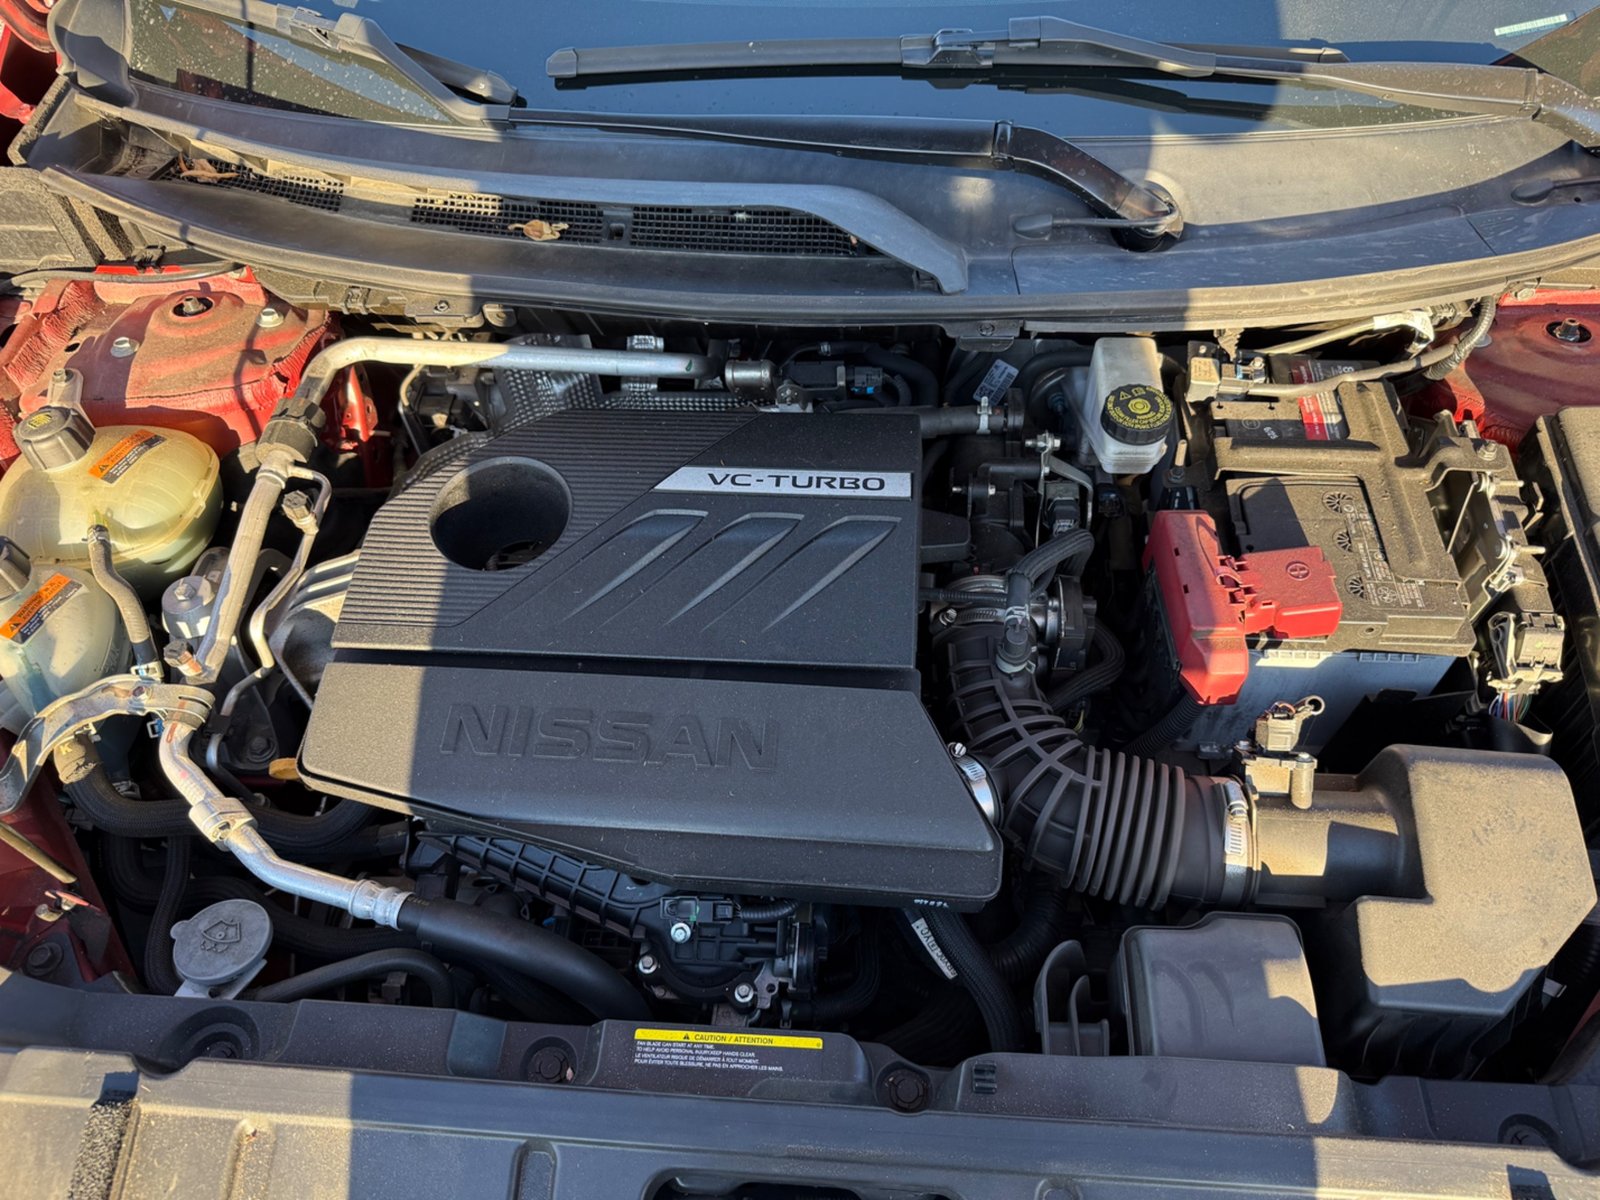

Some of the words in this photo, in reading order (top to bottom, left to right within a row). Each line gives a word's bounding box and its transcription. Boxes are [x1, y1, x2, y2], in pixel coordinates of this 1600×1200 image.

[708, 472, 886, 492] VC-TURBO
[440, 703, 779, 774] NISSAN
[732, 1036, 773, 1044] ATTENTION
